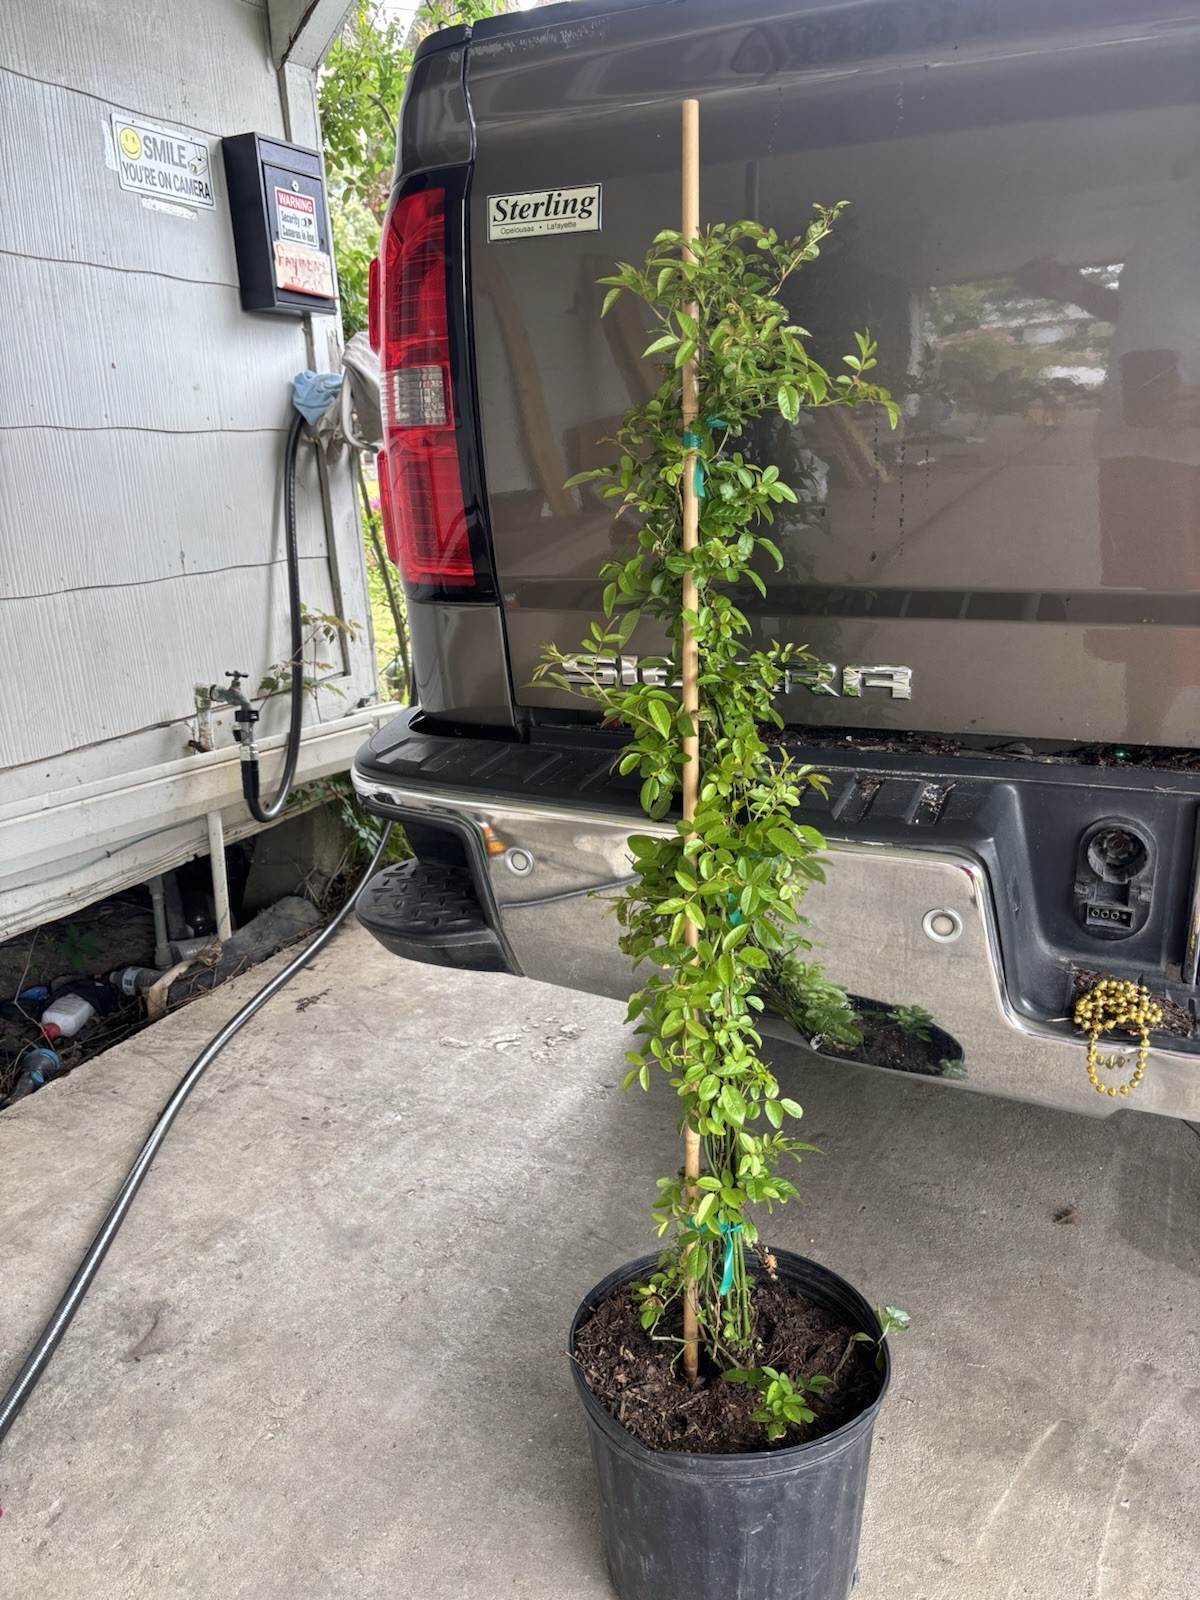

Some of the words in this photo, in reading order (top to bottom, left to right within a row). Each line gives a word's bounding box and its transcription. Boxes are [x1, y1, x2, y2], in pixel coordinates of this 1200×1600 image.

[143, 135, 187, 169] SMILE
[122, 161, 157, 186] YOU'RE
[158, 171, 172, 190] ON
[173, 174, 211, 200] CAMERA
[278, 192, 313, 213] WARNING
[492, 192, 596, 222] Sterling
[281, 210, 300, 228] Security
[500, 226, 535, 236] Opelousas
[546, 221, 577, 230] Lafayette
[282, 224, 302, 239] Cameras
[307, 230, 315, 243] Use
